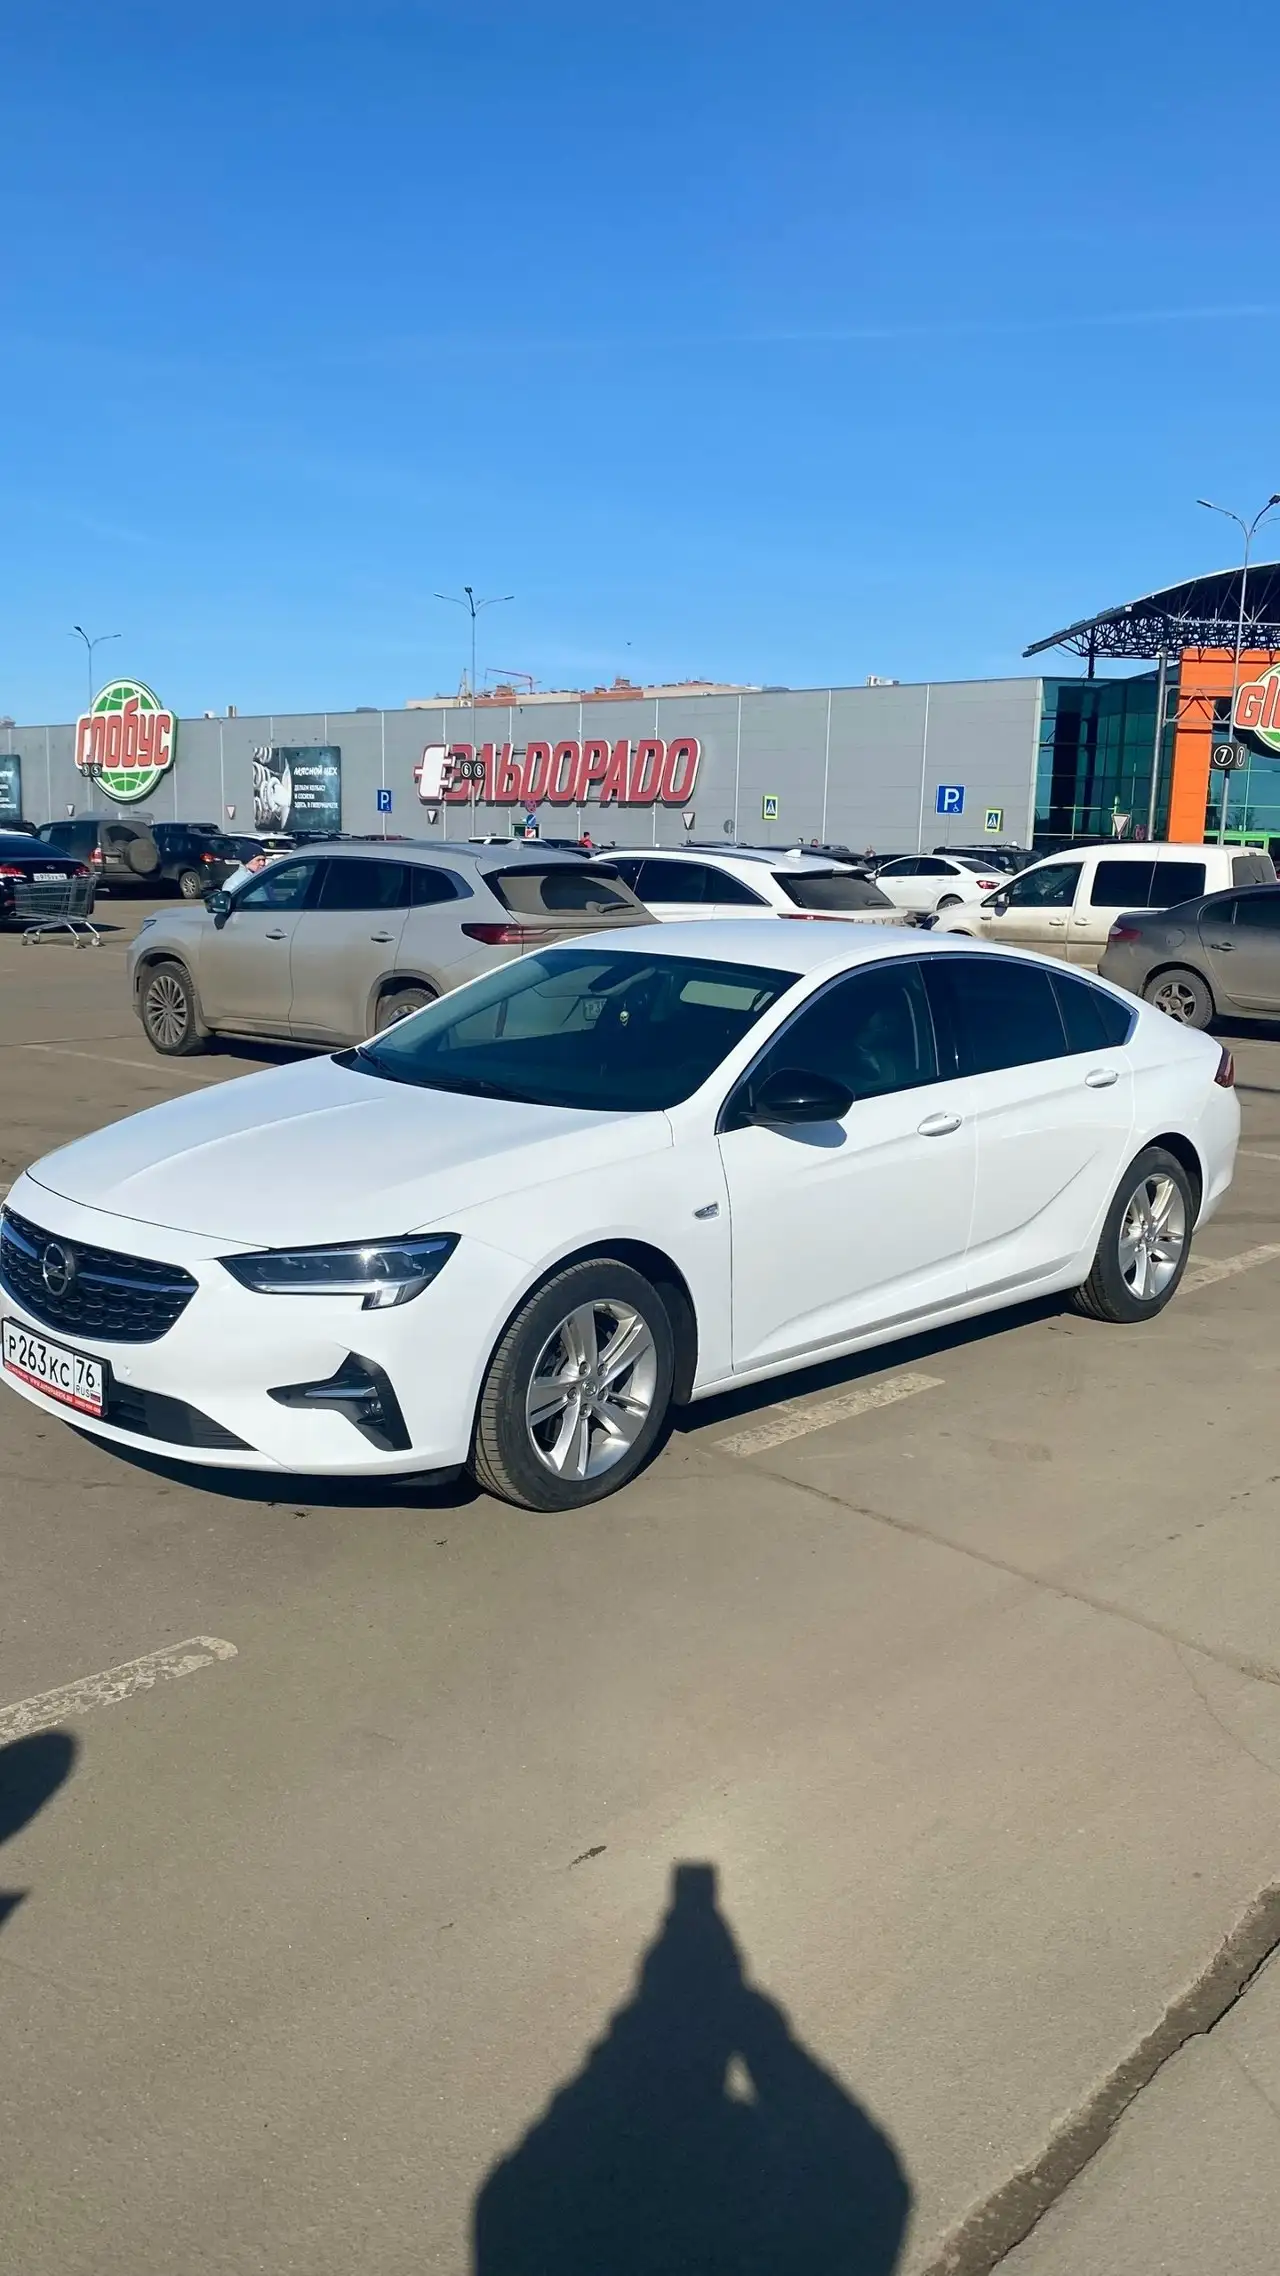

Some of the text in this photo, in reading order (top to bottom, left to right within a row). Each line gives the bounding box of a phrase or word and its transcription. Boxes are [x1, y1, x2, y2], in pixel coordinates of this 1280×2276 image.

[381, 791, 389, 809] P
[944, 788, 960, 811] P
[76, 1358, 95, 1389] 76
[75, 1384, 91, 1398] RUS
